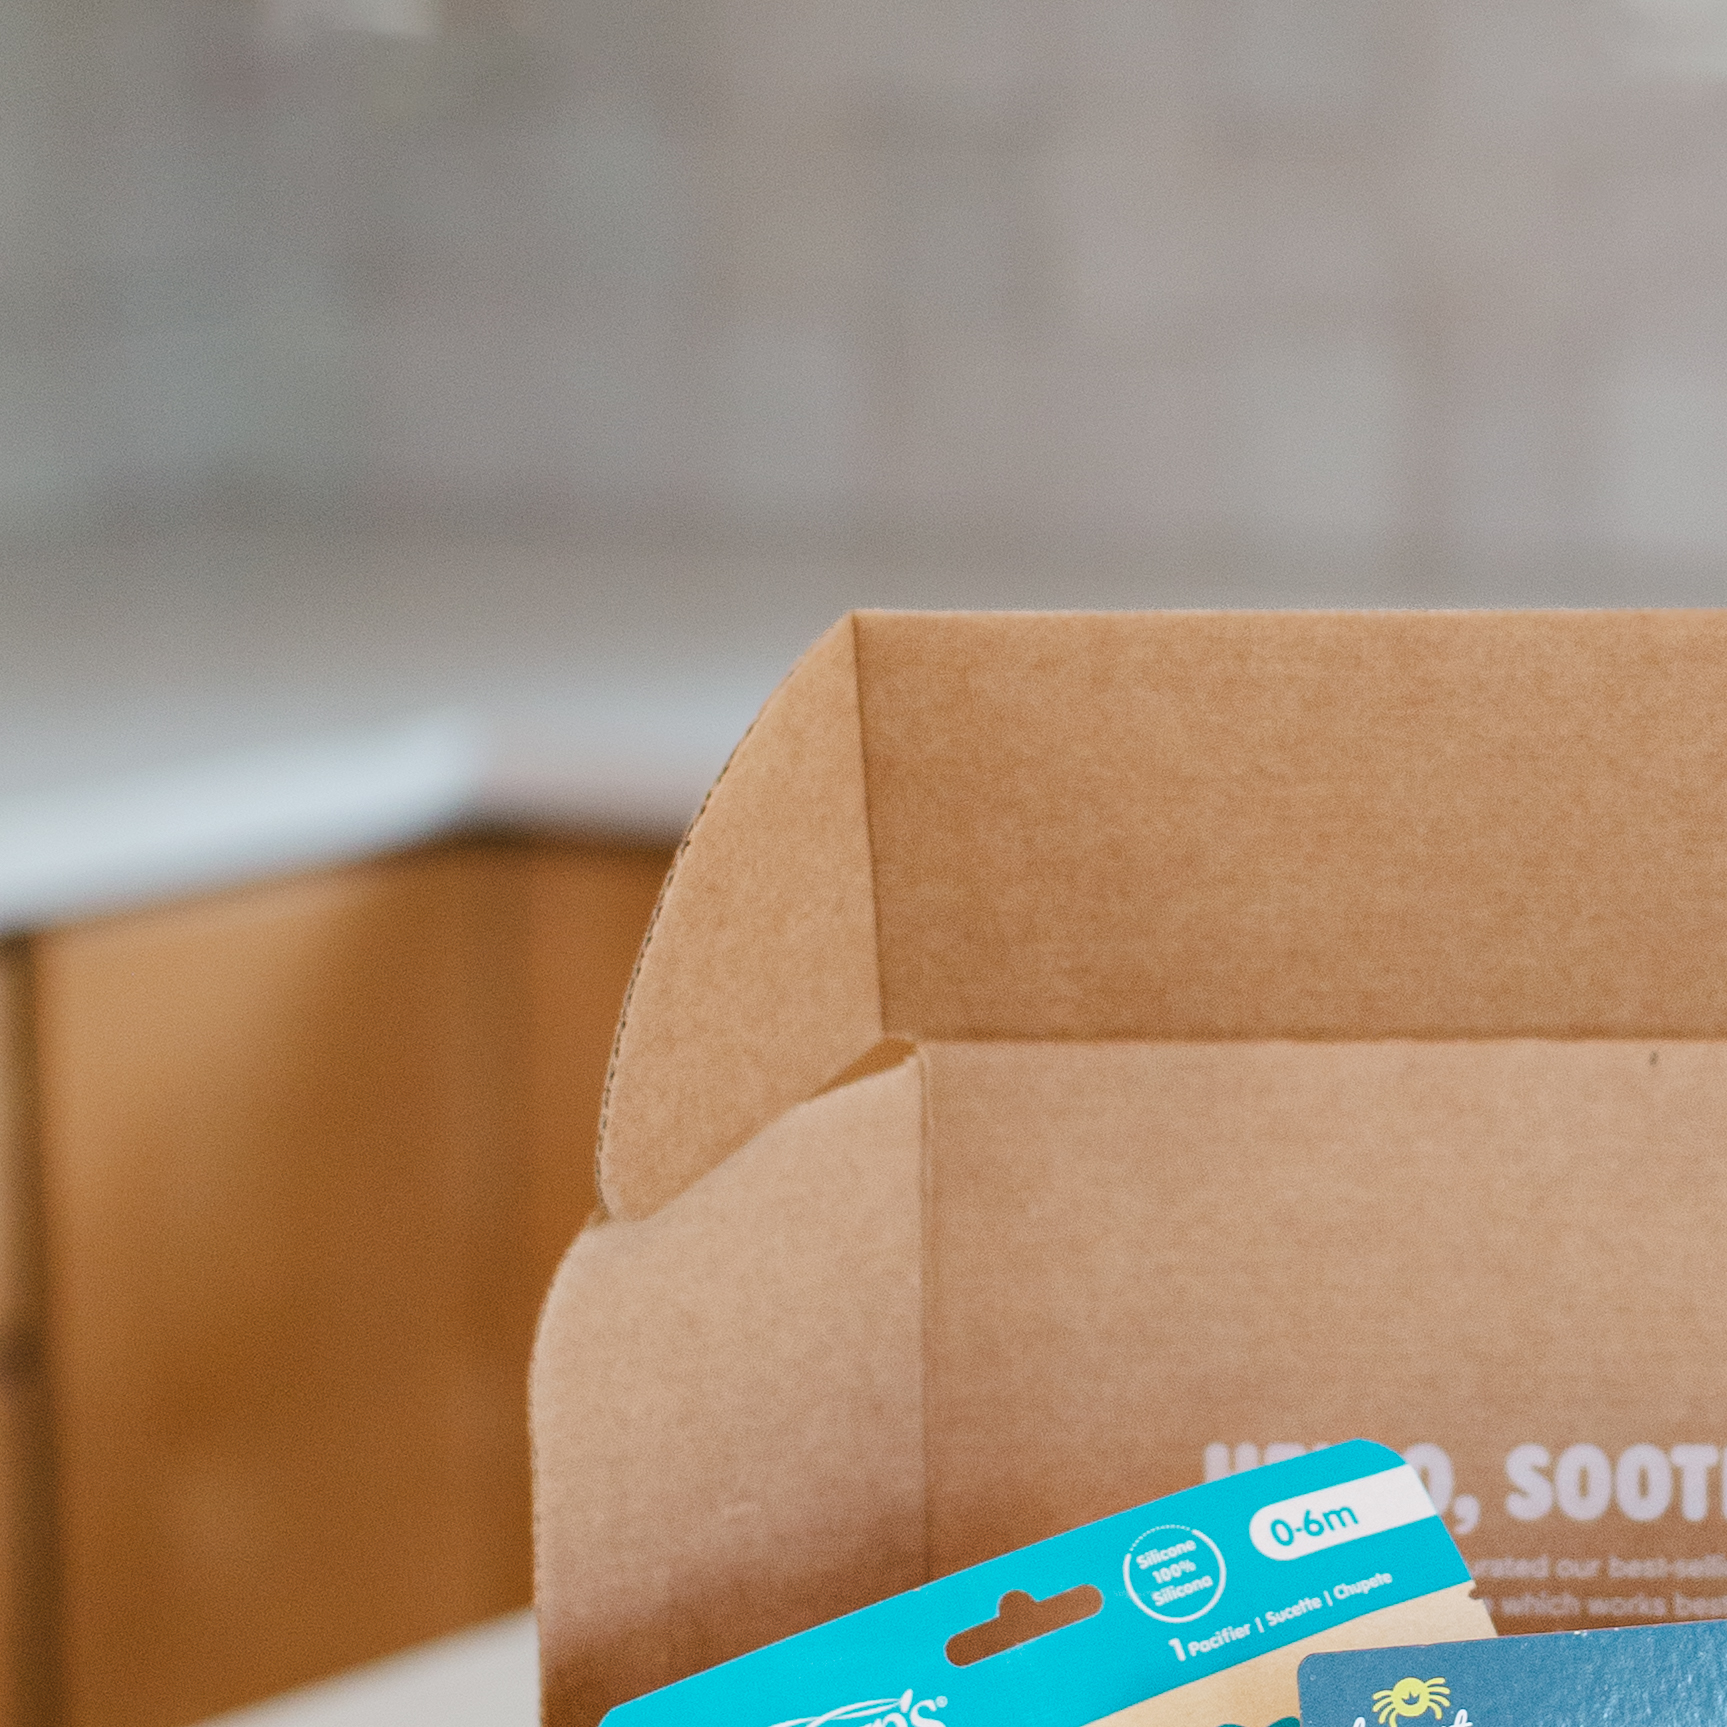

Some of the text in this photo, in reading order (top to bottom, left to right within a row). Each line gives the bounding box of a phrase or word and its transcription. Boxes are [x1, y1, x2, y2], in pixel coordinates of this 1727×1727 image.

[1270, 1506, 1359, 1546] 0-6m
[1136, 1540, 1197, 1570] Silicone
[1152, 1559, 1197, 1584] 100%
[1151, 1575, 1214, 1607] Silicona
[1168, 1637, 1187, 1662] 1
[1187, 1623, 1251, 1657] Pacifier
[1265, 1595, 1322, 1627] Sucette
[1333, 1571, 1393, 1600] Chupete
